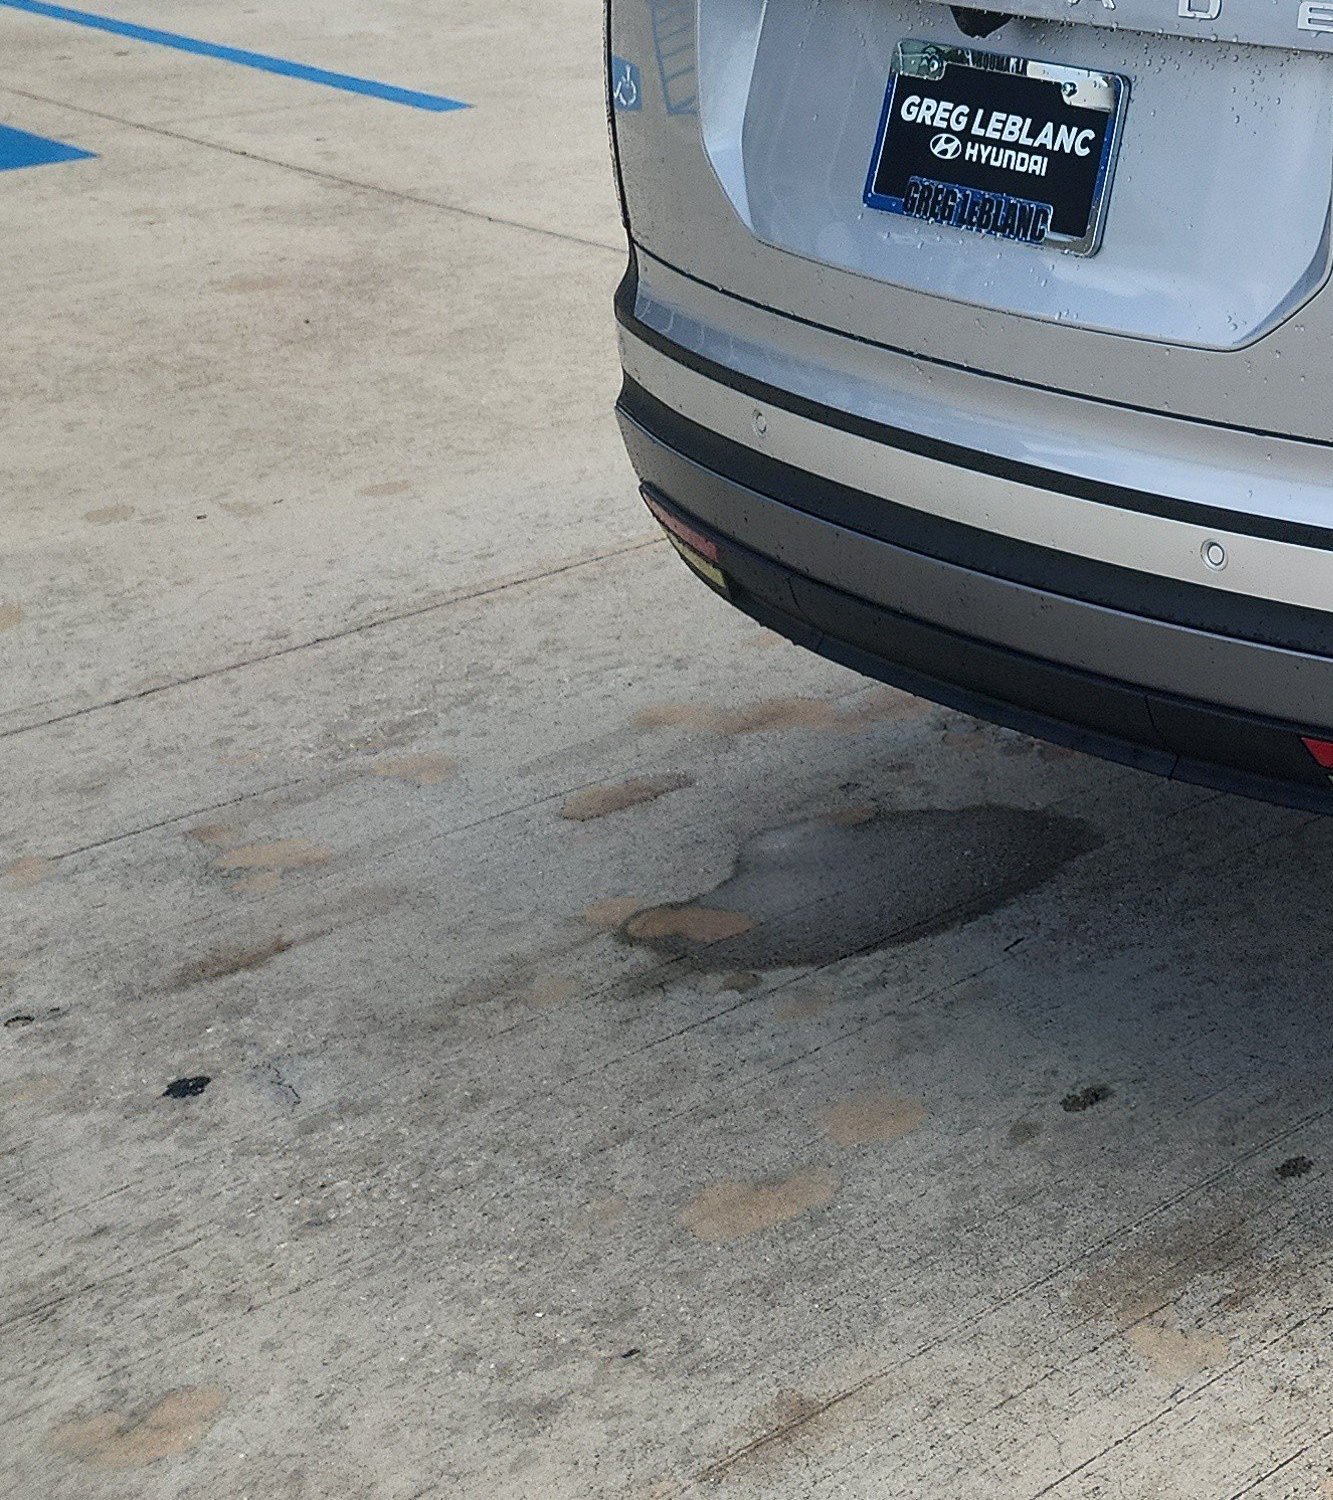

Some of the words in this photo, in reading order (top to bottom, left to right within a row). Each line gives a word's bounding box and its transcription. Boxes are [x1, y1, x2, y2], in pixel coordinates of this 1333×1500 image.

[901, 95, 970, 132] GREG
[970, 108, 1096, 157] LEBLANC
[964, 141, 1049, 177] HYUNDAI
[904, 182, 958, 222] GREG
